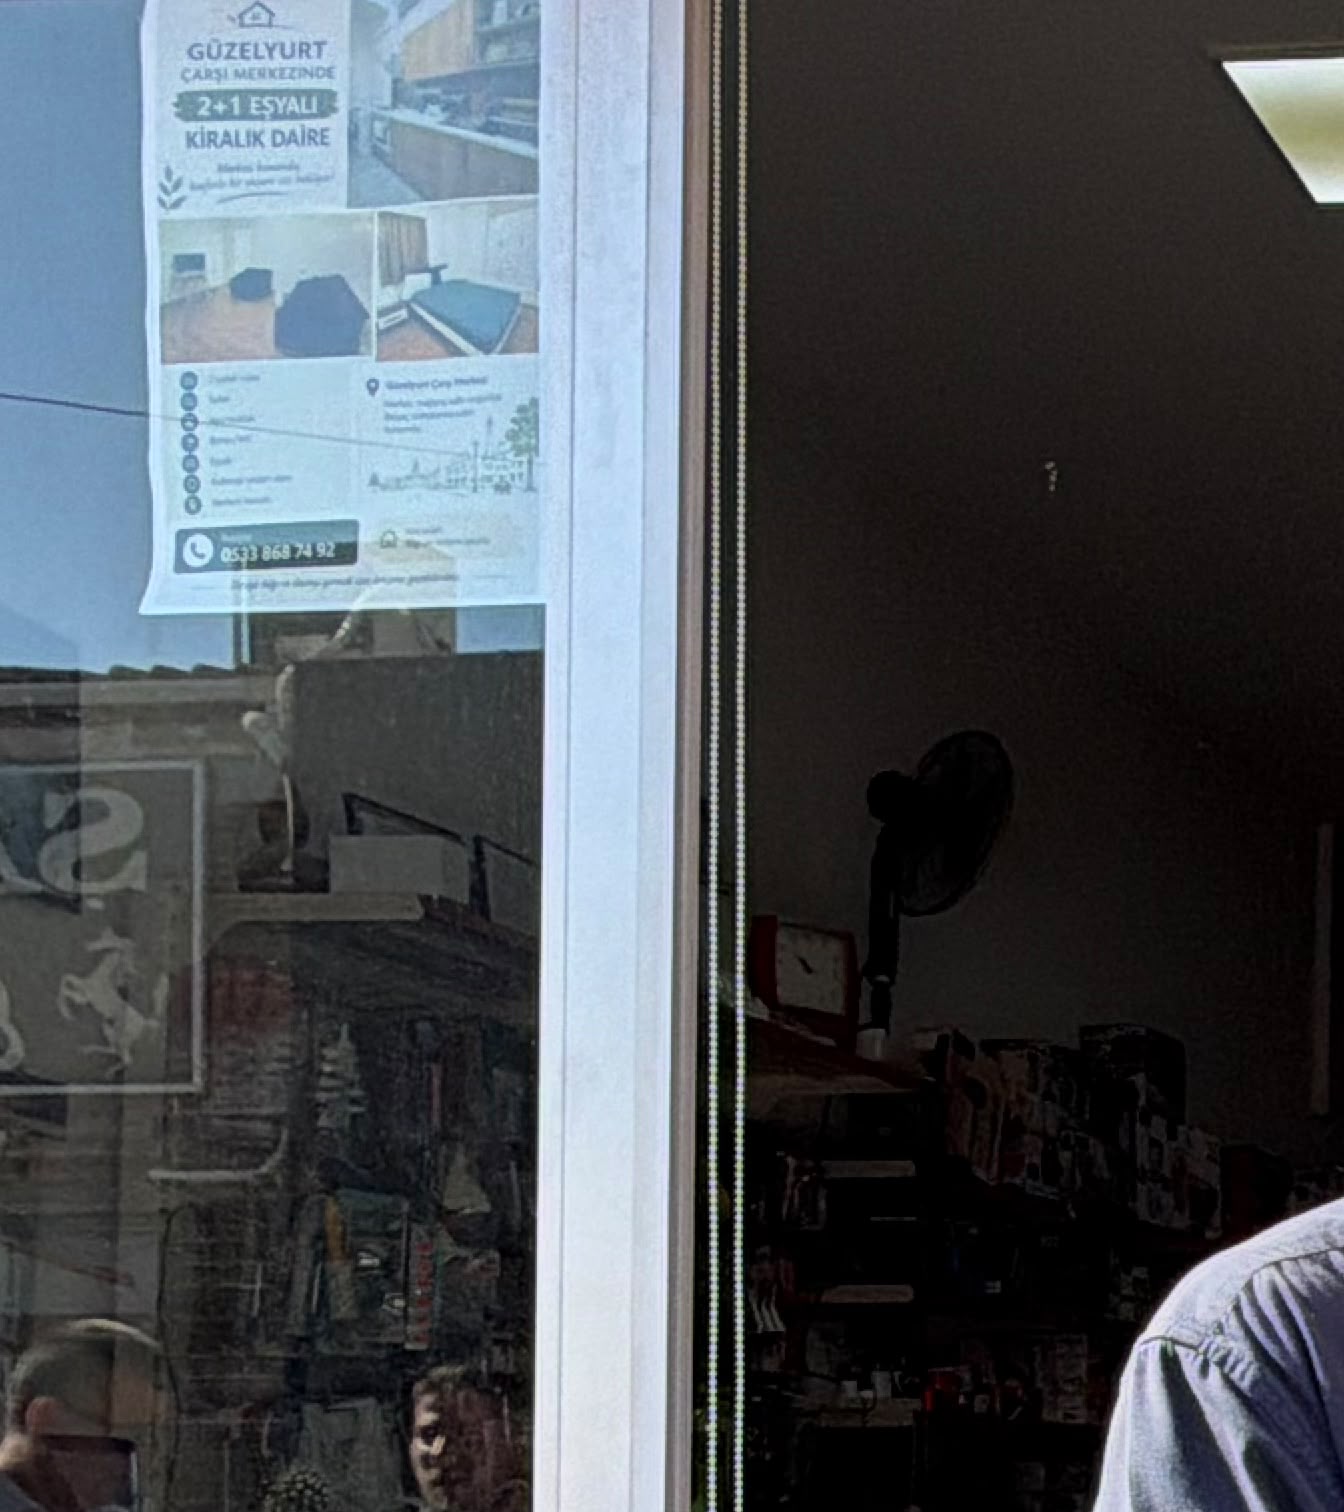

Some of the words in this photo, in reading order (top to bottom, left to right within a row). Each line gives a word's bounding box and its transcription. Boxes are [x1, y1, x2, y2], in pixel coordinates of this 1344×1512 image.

[187, 39, 327, 60] GÜZELYURT
[181, 67, 228, 83] ÇARŞI
[197, 95, 240, 116] 2+1
[250, 95, 318, 119] EŞYALI
[186, 126, 265, 149] KİRALIK
[271, 124, 330, 147] DAİRE
